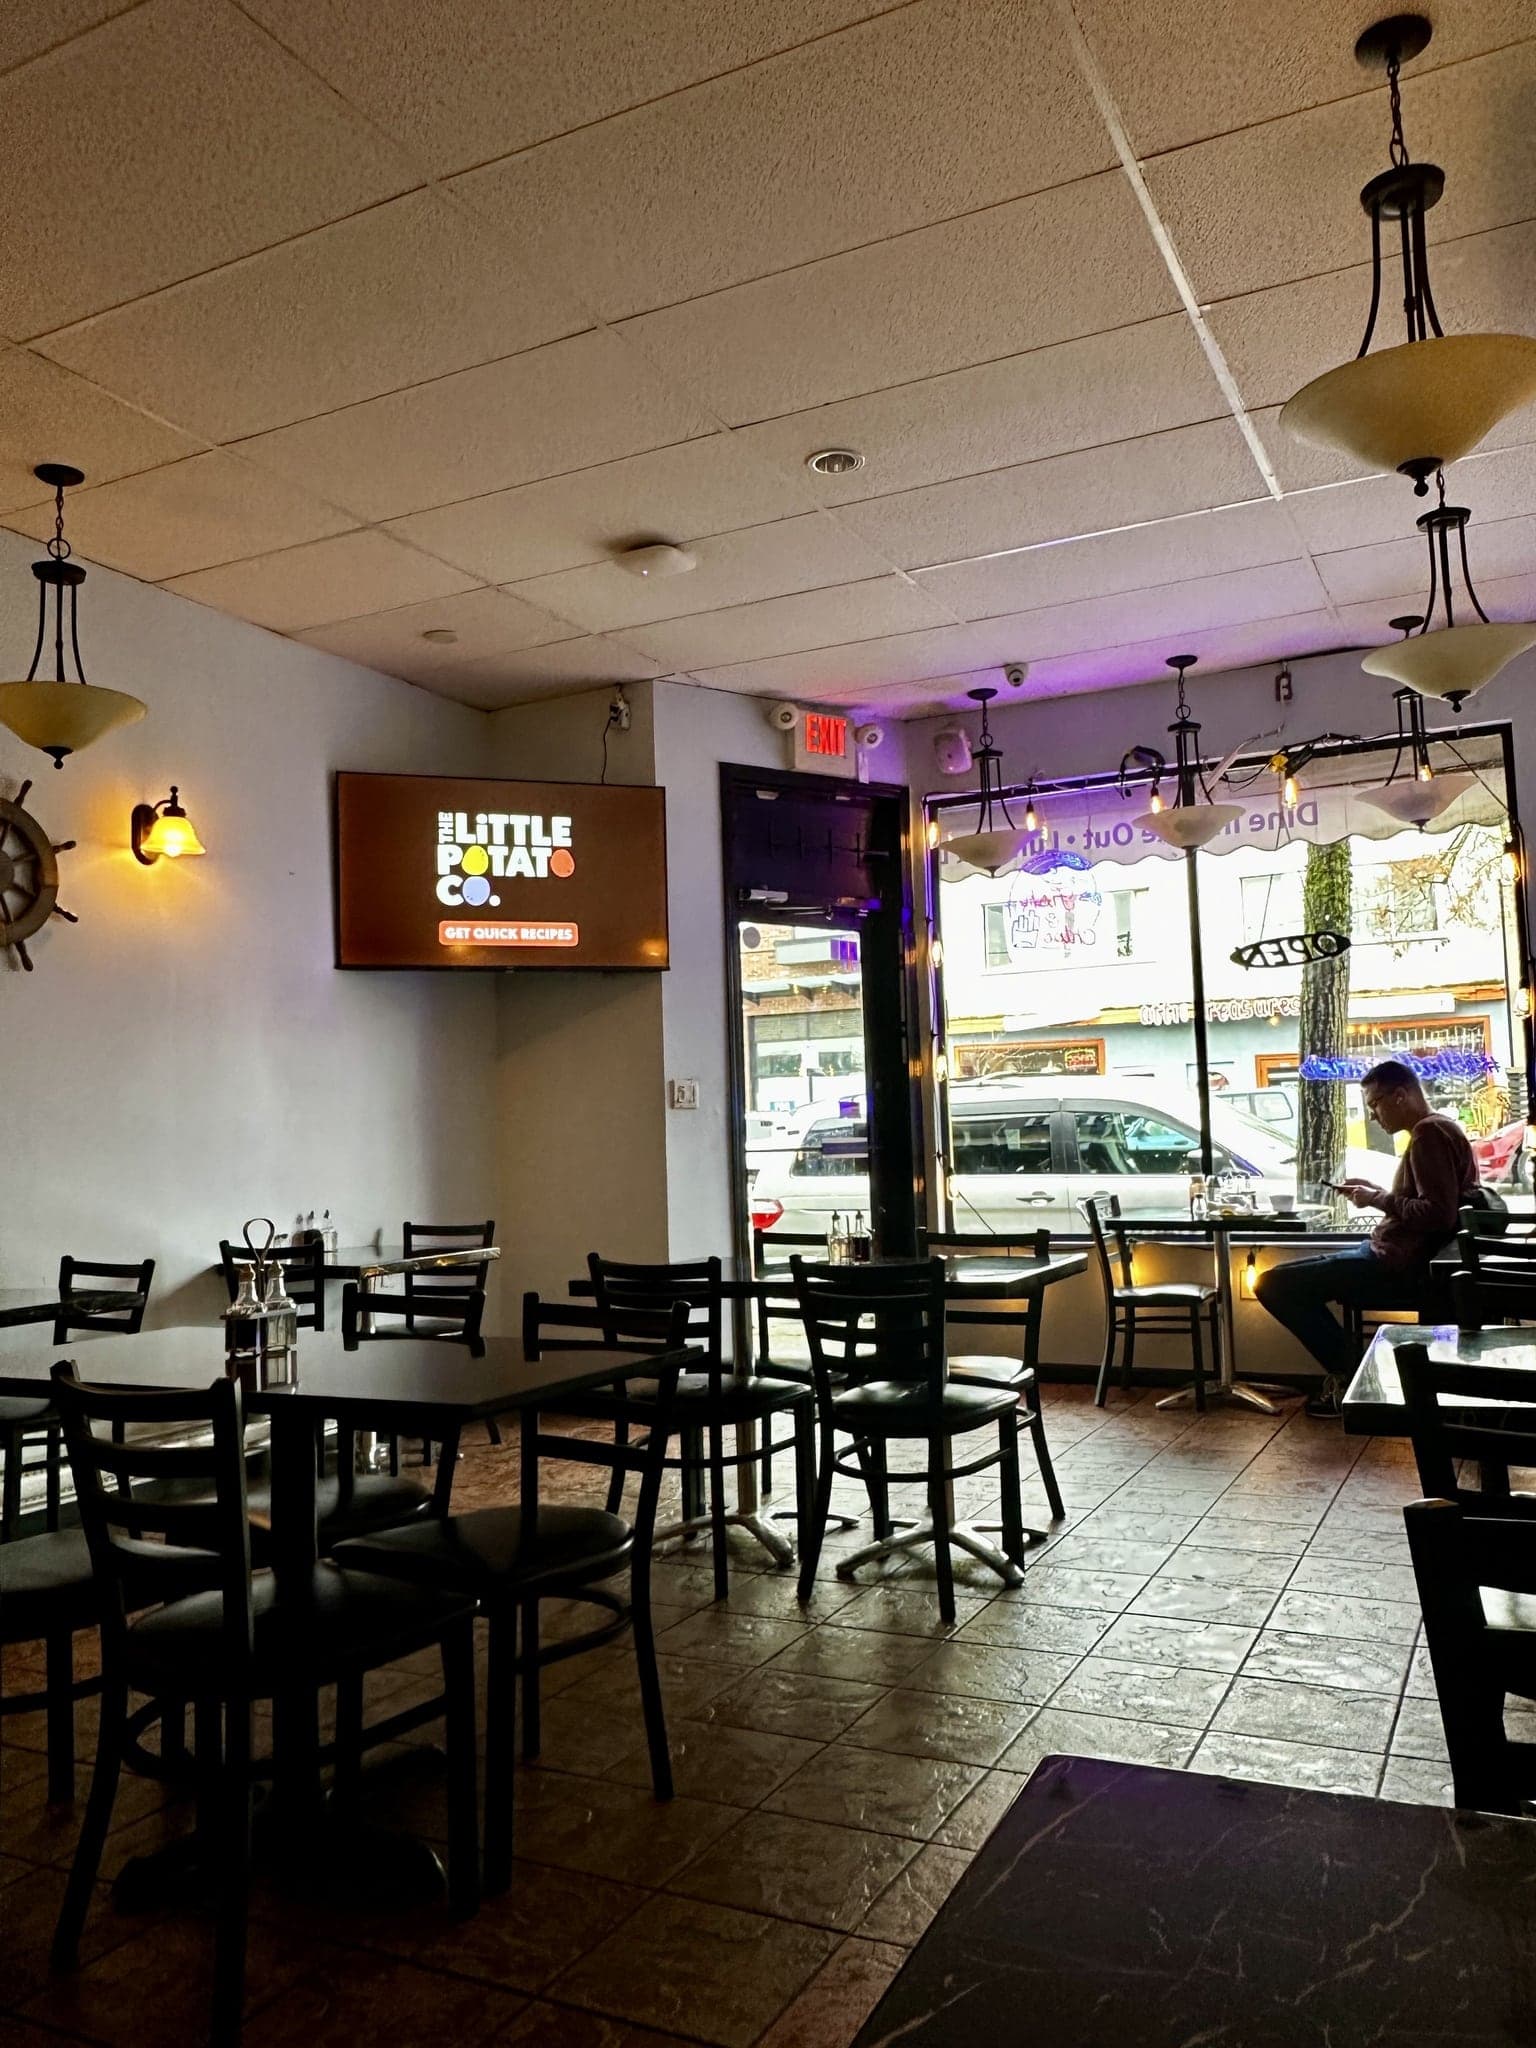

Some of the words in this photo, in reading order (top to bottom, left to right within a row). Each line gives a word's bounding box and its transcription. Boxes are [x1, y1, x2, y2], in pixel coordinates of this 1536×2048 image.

[806, 712, 847, 756] EXIT
[438, 812, 454, 844] THE
[437, 844, 576, 878] POTATO
[436, 875, 501, 907] CO.
[445, 927, 471, 939] GET
[473, 928, 518, 940] QUICK
[521, 928, 573, 940] RECIPES
[1205, 997, 1300, 1022] reasures
